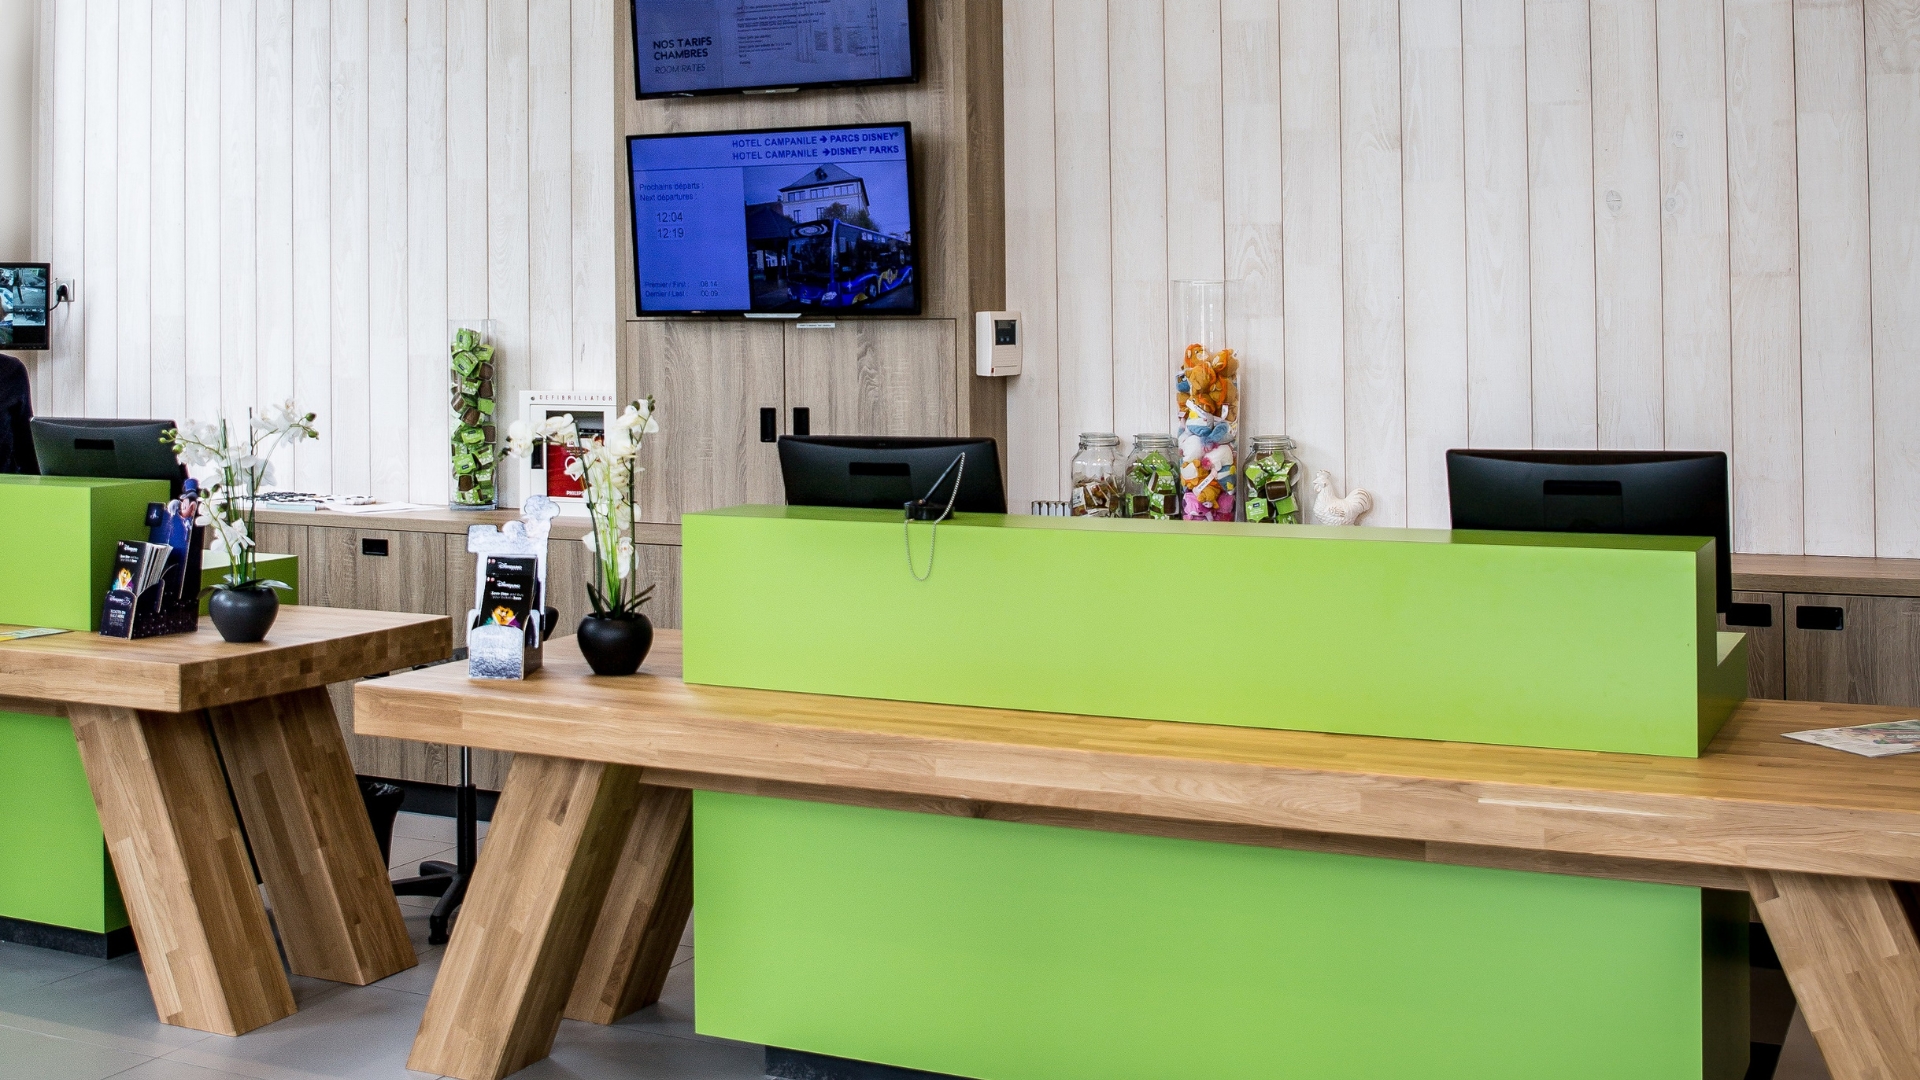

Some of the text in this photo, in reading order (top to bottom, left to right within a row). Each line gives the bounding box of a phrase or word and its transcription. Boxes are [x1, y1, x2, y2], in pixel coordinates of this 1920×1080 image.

[653, 36, 713, 49] NOS TARIFS
[653, 48, 709, 61] CHAMBRES
[655, 63, 706, 74] ROOM RATES
[732, 138, 762, 148] HOTEL
[764, 136, 818, 147] CAMPANILE
[829, 132, 860, 143] PARCS
[732, 150, 763, 160] HOTEL
[765, 148, 819, 159] CAMPANILE
[869, 145, 900, 155] PARKS
[639, 182, 673, 191] Prochains
[639, 194, 656, 202] Next
[656, 211, 683, 223] 12:04
[657, 227, 684, 239] 12:19
